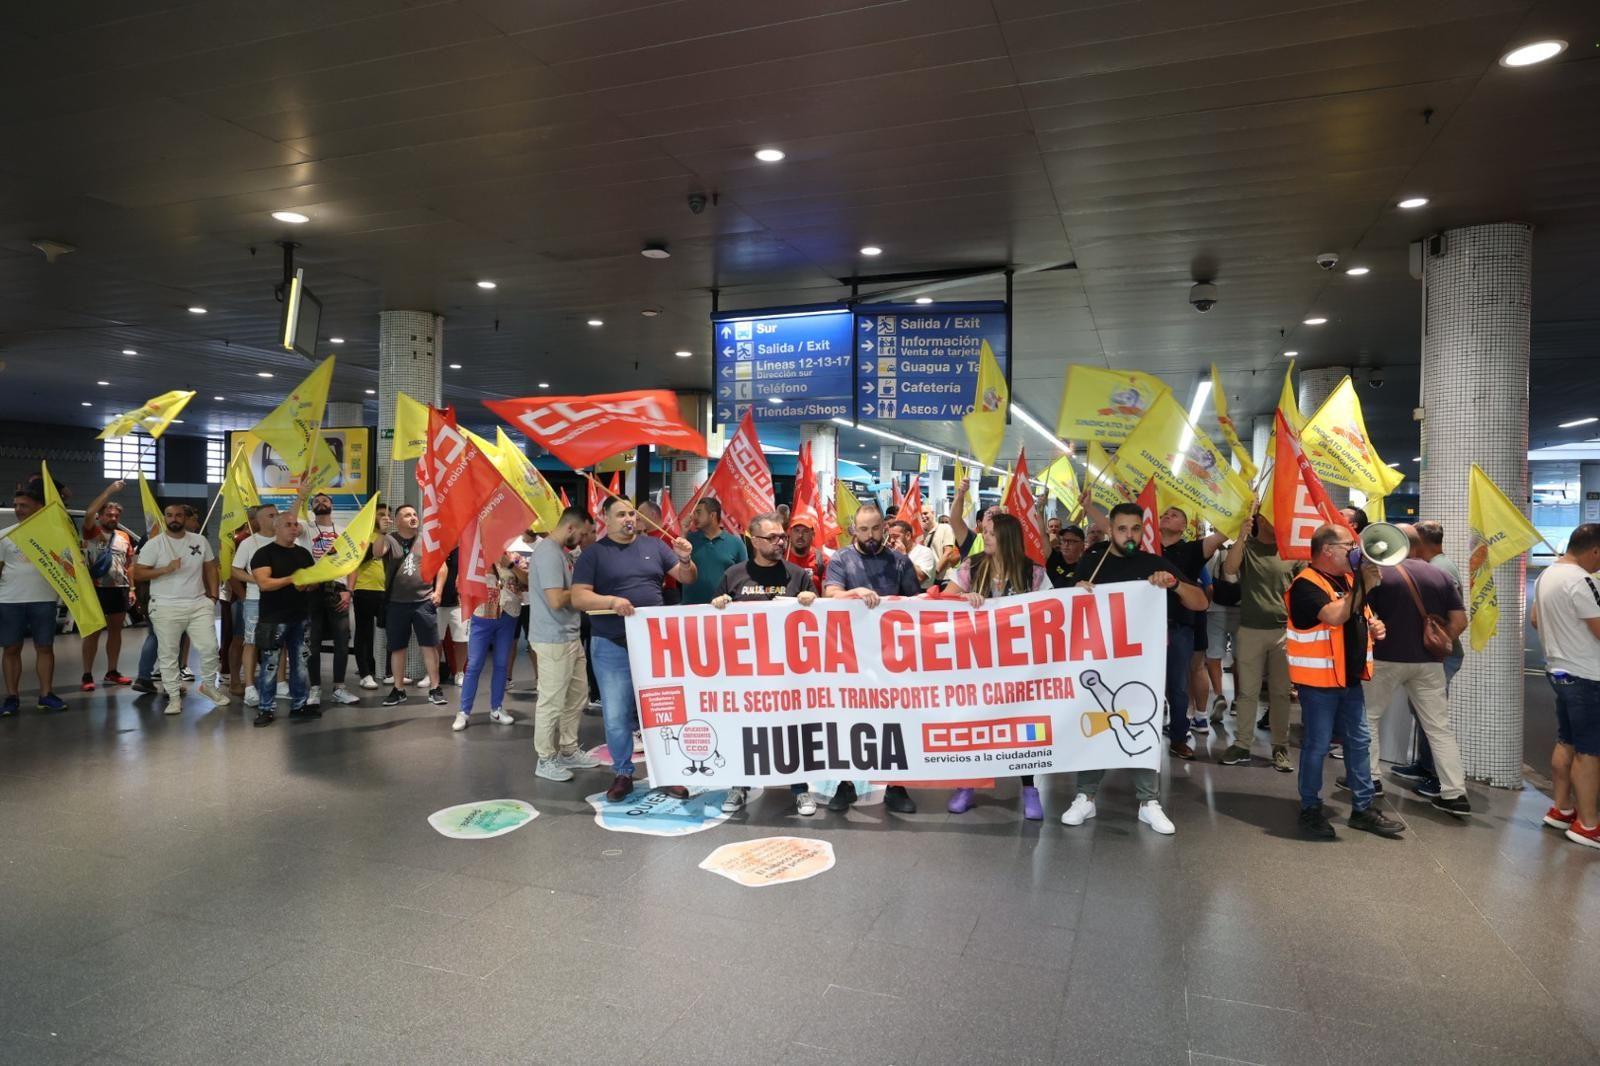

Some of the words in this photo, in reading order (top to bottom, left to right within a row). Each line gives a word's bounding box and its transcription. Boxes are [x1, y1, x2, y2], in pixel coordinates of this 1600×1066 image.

[757, 323, 777, 334] Sur
[901, 318, 940, 329] Salida
[944, 317, 951, 329] /
[954, 317, 980, 329] Exit
[758, 342, 794, 354] Salida
[797, 341, 803, 352] /
[807, 339, 830, 351] Exit
[901, 335, 979, 347] Información
[901, 348, 928, 356] Venta
[931, 347, 944, 356] de
[800, 355, 850, 369] 12-13-17
[901, 361, 950, 374] Guagua
[955, 363, 963, 374] y
[757, 369, 797, 379] Dirección
[757, 382, 808, 394] Teléfono
[756, 404, 847, 417] Tiendas/Shops
[941, 404, 947, 415] /
[1139, 450, 1185, 485] SINDICATO
[1184, 483, 1233, 518] UNIFICADO
[28, 537, 62, 577] SINDICATO
[46, 568, 77, 603] GUAGUAS
[647, 609, 859, 678] HUELGA
[881, 592, 1143, 672] GENERAL
[700, 691, 718, 713] EN
[723, 691, 740, 713] EL
[744, 689, 801, 712] SECTOR
[806, 687, 834, 709] DEL
[839, 685, 940, 709] TRANSPORTE
[945, 683, 977, 707] POR
[982, 676, 1075, 705] CARRETERA
[928, 724, 1011, 747] CCOO
[742, 722, 909, 776] HUELGA
[924, 753, 971, 764] servicios
[983, 753, 993, 761] la
[995, 749, 1052, 761] ciudadanía
[1008, 760, 1053, 771] canarias
